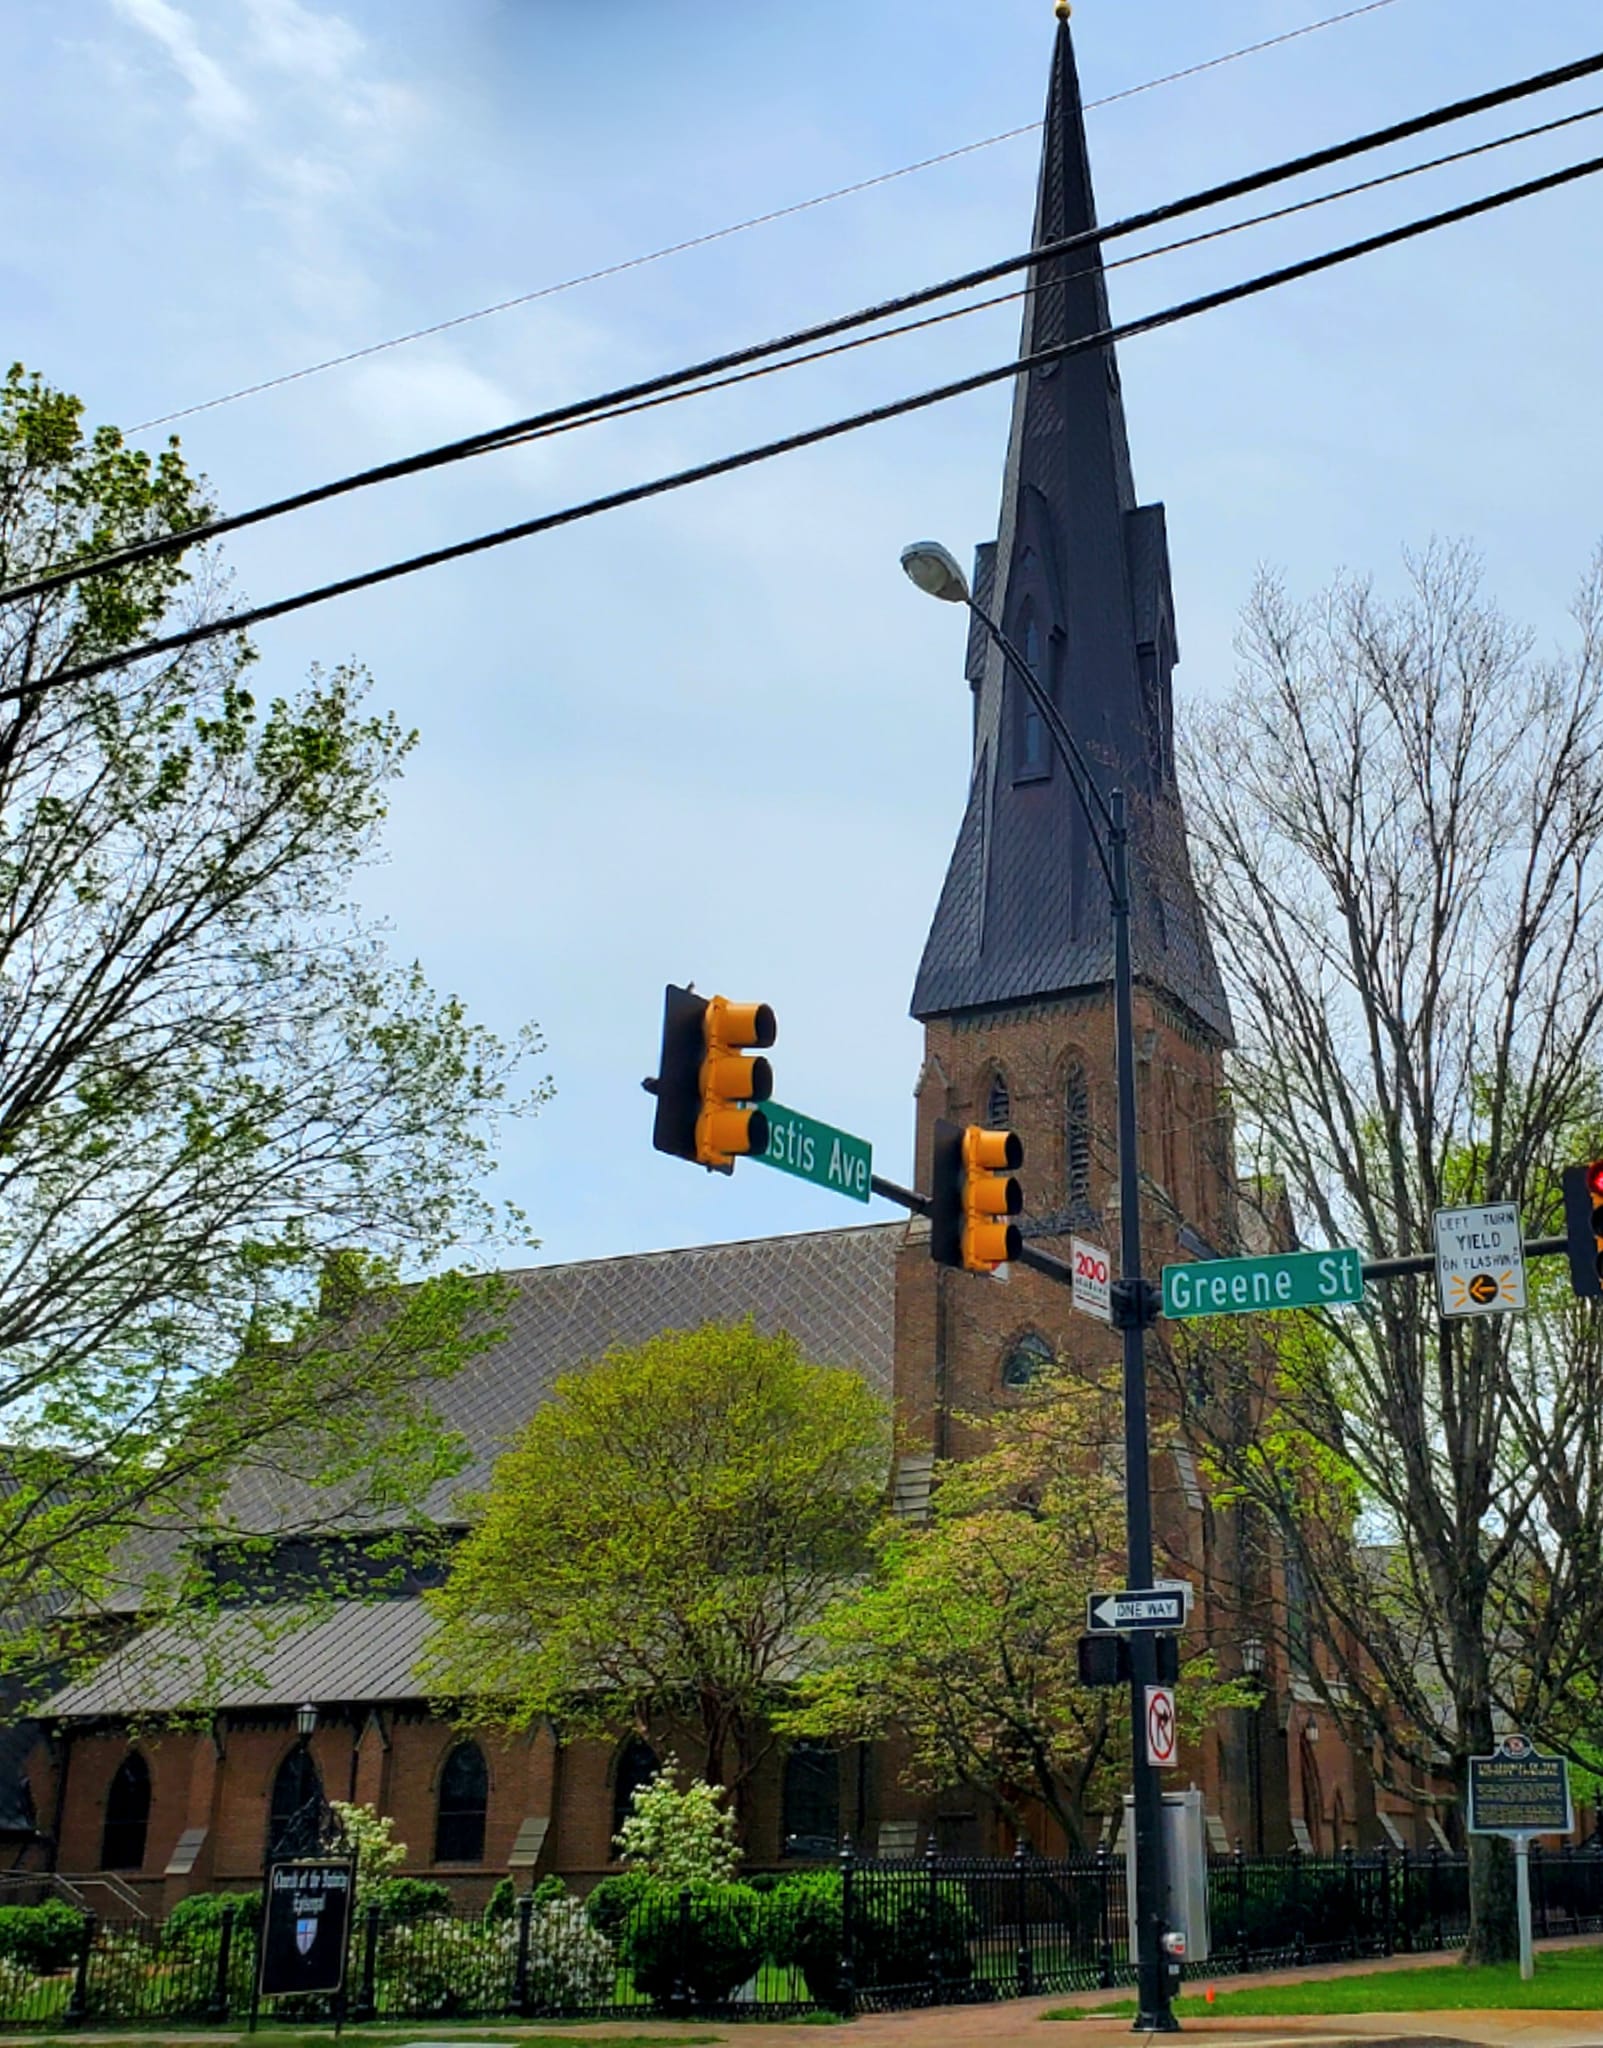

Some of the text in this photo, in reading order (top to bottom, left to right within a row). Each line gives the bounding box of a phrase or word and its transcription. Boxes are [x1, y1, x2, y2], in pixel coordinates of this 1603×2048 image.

[828, 1137, 868, 1192] Ave
[1440, 1211, 1514, 1232] LEFT TURN
[1456, 1231, 1501, 1251] YIELD
[1075, 1251, 1107, 1284] 200
[1442, 1258, 1458, 1271] ON
[1171, 1256, 1353, 1309] Greene St
[1117, 1601, 1174, 1617] ONE WAY
